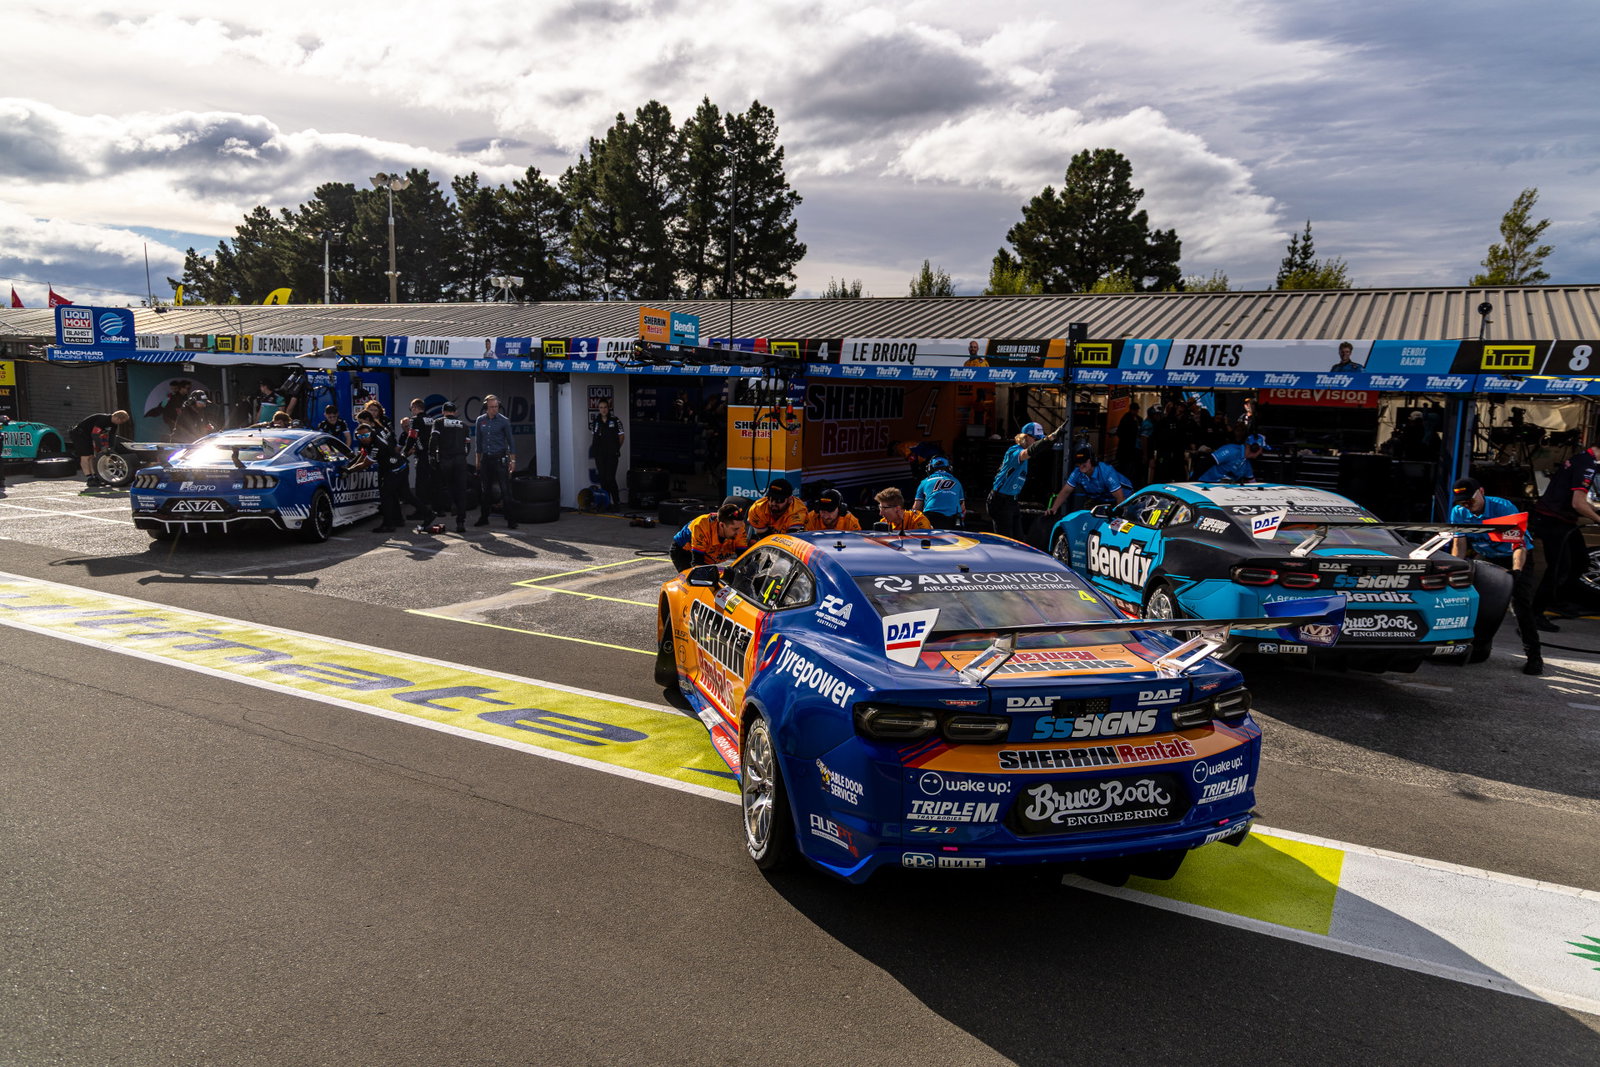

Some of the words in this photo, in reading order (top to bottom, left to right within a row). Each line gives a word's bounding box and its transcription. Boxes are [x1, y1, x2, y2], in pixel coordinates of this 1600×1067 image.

[644, 316, 666, 326] SHERRIN
[674, 320, 696, 333] Bendix
[239, 338, 249, 350] 18
[259, 338, 267, 351] DE
[269, 338, 303, 352] PASQUALE
[393, 339, 400, 354] 7
[414, 339, 449, 355] GOLDING
[579, 341, 588, 357] 3
[996, 345, 1016, 353] SHERRIN
[1018, 345, 1040, 353] RENTALS
[818, 342, 828, 360] 4
[852, 343, 868, 361] LE
[872, 343, 917, 365] BROCQ
[1133, 343, 1159, 365] 10
[1183, 344, 1243, 367] BATES
[1402, 347, 1427, 357] BENDIX
[1400, 357, 1426, 366] RACING
[1568, 345, 1593, 371] 8
[572, 361, 590, 371] Thrifty
[598, 362, 617, 371] Thrifty
[810, 365, 832, 375] Thrifty
[842, 366, 866, 376] Thrifty
[877, 367, 901, 377] Thrifty
[913, 367, 938, 378] Thrifty
[950, 368, 976, 379] Thrifty
[989, 369, 1016, 380] Thrifty
[1029, 369, 1058, 381] Thrifty
[1078, 370, 1108, 381] Thrifty
[1122, 371, 1153, 383] Thrifty
[1167, 372, 1200, 384] Thrifty
[1215, 373, 1249, 385] Thrifty
[1265, 374, 1300, 386] Thrifty
[1316, 375, 1354, 387] Thrifty
[1370, 376, 1410, 388] Thrifty
[1427, 376, 1468, 390] Thrifty
[1546, 378, 1590, 392] Thrifty
[590, 388, 612, 397] LIQUI
[806, 384, 904, 420] SHERRIN
[916, 388, 940, 436] 4
[735, 421, 780, 430] SHERRIN
[4, 432, 33, 446] RIVER
[741, 430, 772, 438] Rentals
[821, 422, 889, 456] Rentals
[933, 478, 956, 491] 10
[1254, 516, 1279, 530] DAF
[1088, 533, 1152, 588] Bendix
[918, 573, 966, 584] AIR
[972, 572, 1071, 583] CONTROL
[924, 583, 1018, 592] AIR-CONDITIONING
[1079, 590, 1097, 603] 4
[1337, 591, 1414, 603] Bendix
[819, 594, 853, 620] PCA
[817, 618, 838, 629] AUSTRALIA
[1375, 614, 1418, 630] Rock
[887, 621, 926, 641] DAF
[689, 598, 754, 681] SHERRIN
[776, 640, 856, 708] Tyrepower
[698, 648, 736, 717] Rentals
[1138, 688, 1183, 701] DAF
[1006, 697, 1061, 707] DAF
[998, 747, 1118, 770] SHERRIN
[1117, 739, 1196, 764] Rentals
[1208, 760, 1230, 775] wake
[1231, 756, 1243, 770] up!
[830, 770, 844, 787] ABLE
[845, 778, 864, 796] DOOR
[946, 780, 985, 792] wake
[987, 781, 1011, 795] up!
[831, 784, 858, 806] SERVICES
[1025, 783, 1100, 822] Bruce
[1101, 779, 1171, 804] Rock
[1068, 808, 1169, 826] ENGINEERING
